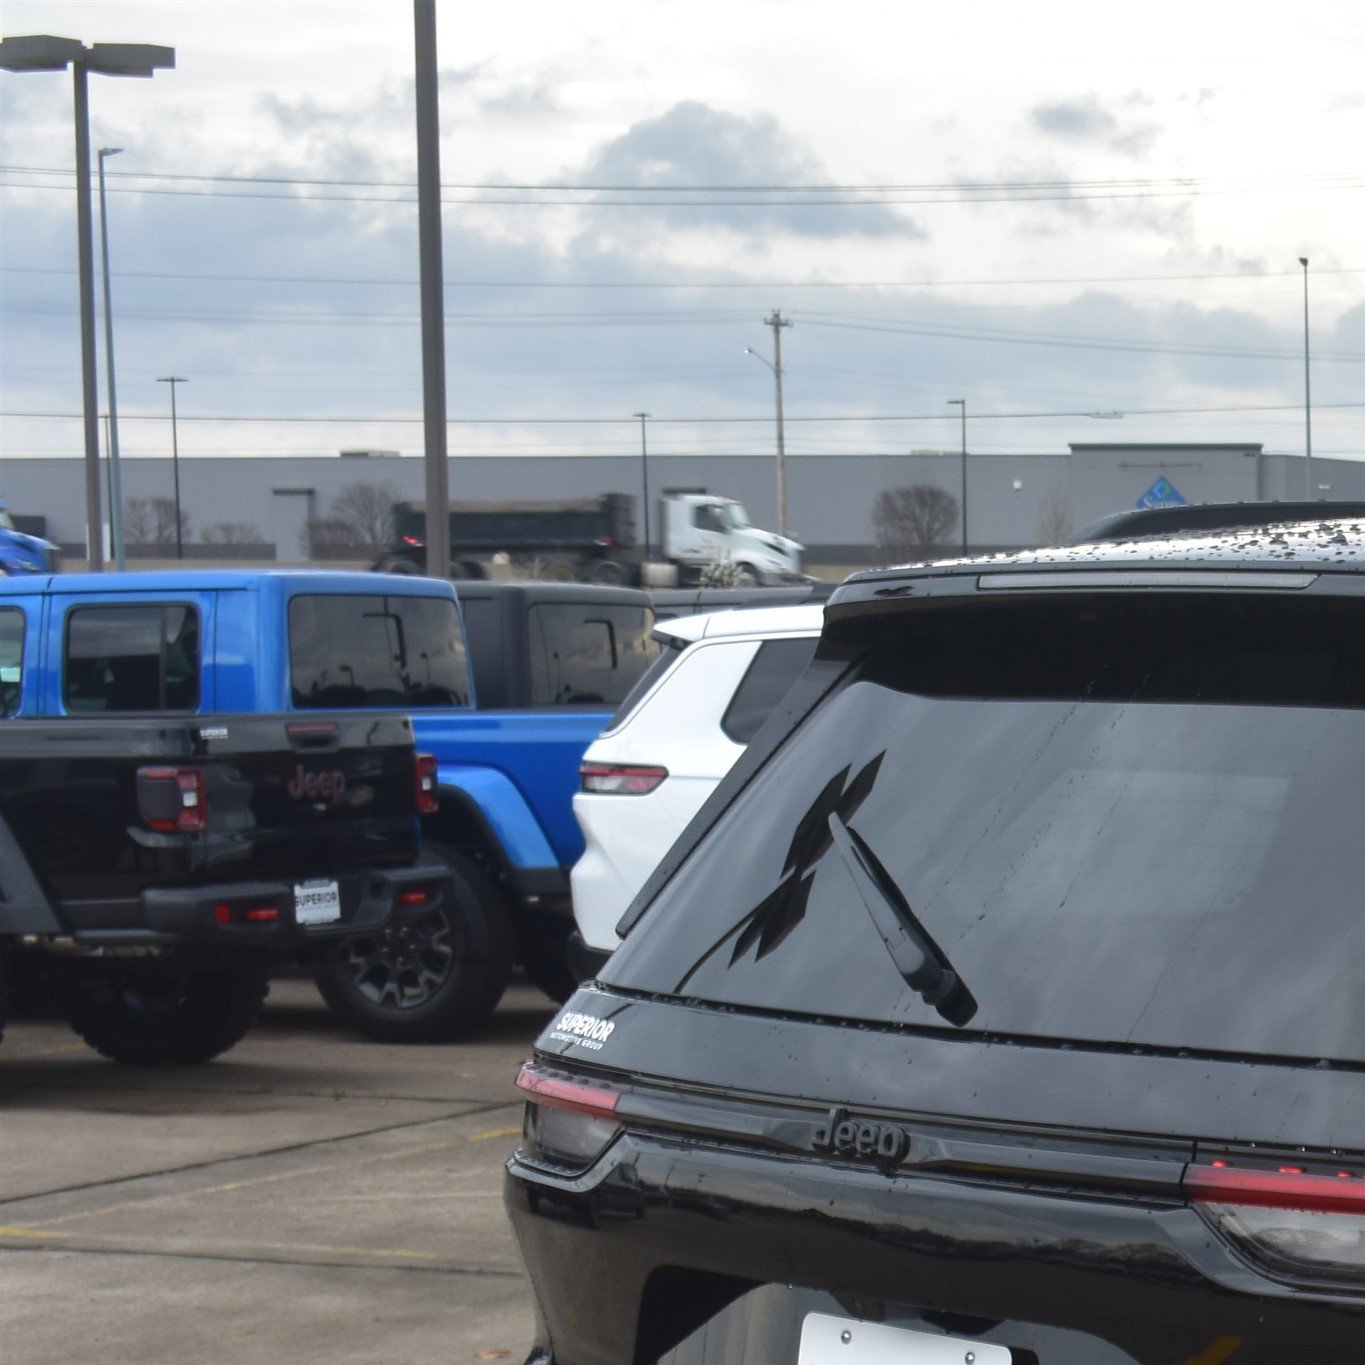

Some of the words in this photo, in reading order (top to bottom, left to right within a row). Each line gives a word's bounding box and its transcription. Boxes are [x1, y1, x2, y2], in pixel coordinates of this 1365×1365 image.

[287, 764, 346, 804] Jeep
[557, 1012, 615, 1042] SUPERIOR
[810, 1104, 908, 1170] Jeep
